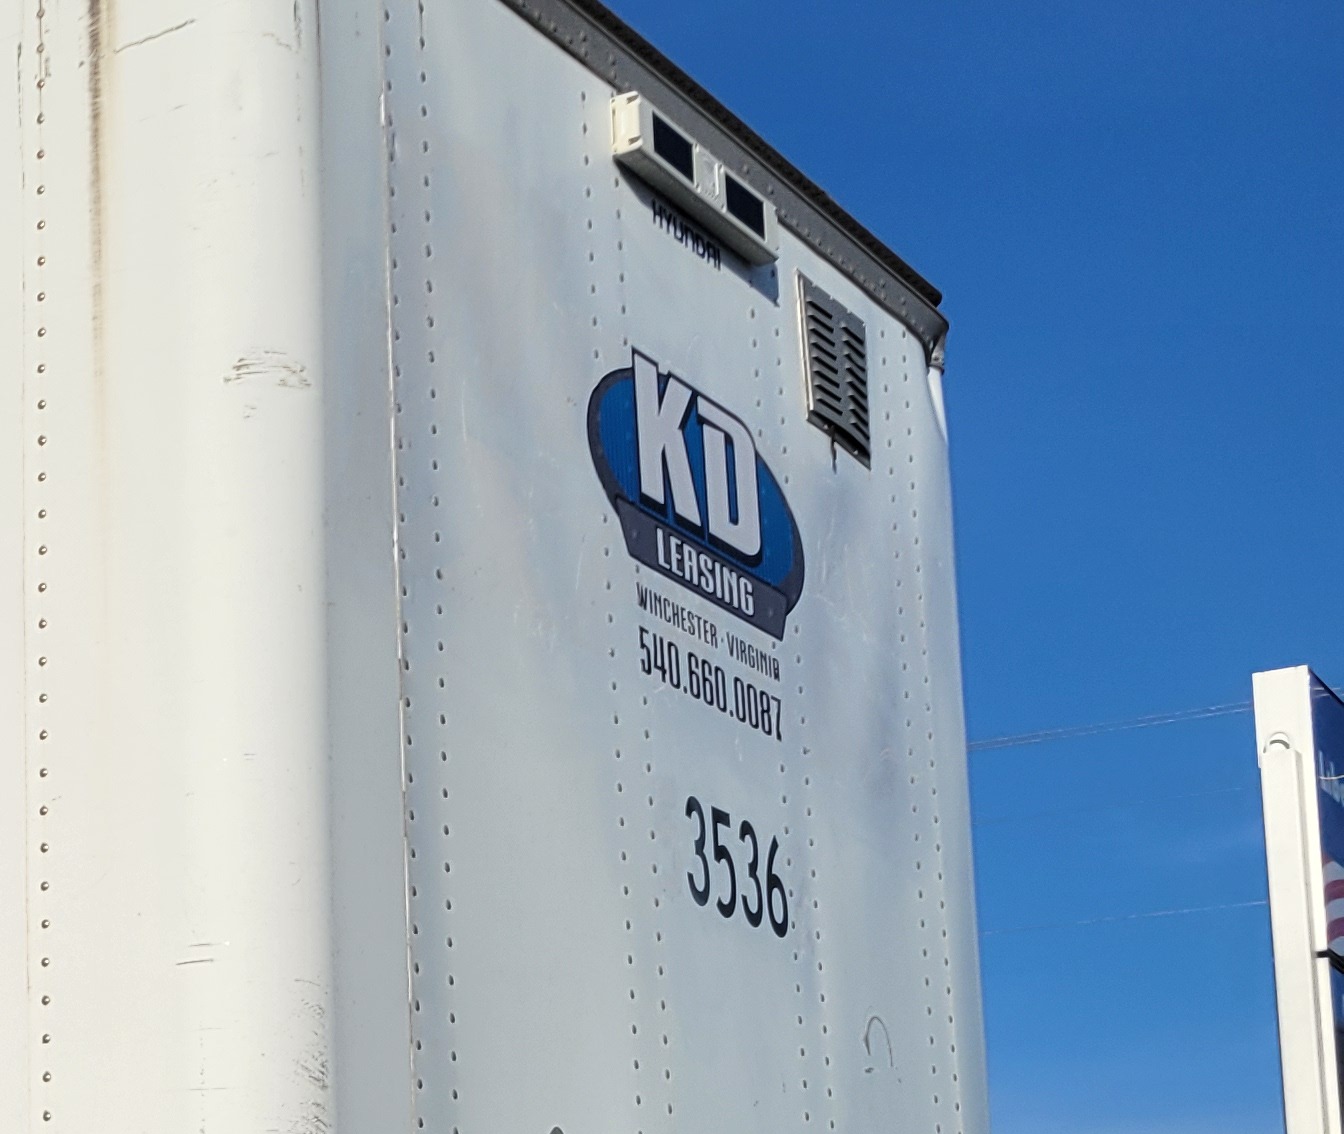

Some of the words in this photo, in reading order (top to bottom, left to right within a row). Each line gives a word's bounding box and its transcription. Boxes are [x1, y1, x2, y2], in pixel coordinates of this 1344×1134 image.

[652, 197, 721, 272] HYUNDAI
[631, 346, 761, 557] KD
[655, 526, 756, 617] LEASING
[636, 581, 718, 648] WINCHESTER
[726, 631, 780, 682] VIRGINIA
[638, 624, 783, 742] 540.660.0087
[685, 795, 789, 938] 3536
